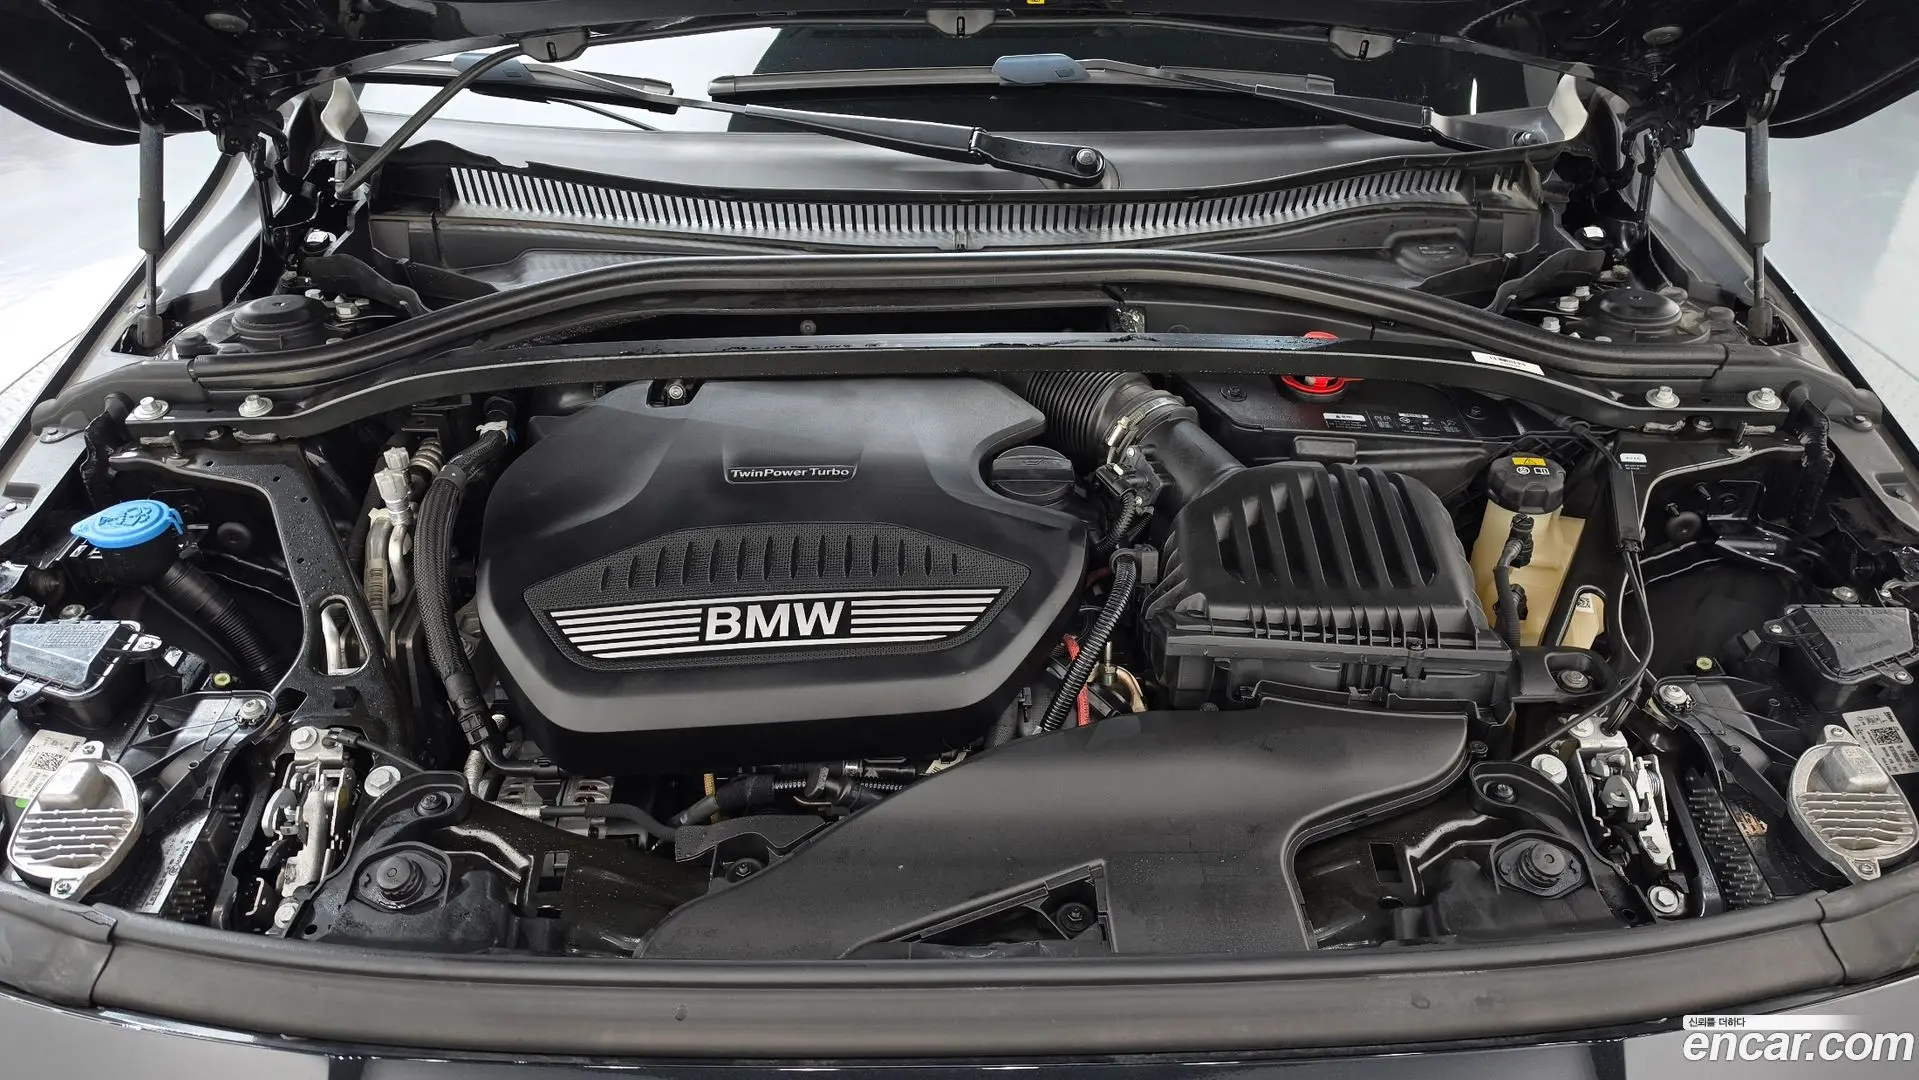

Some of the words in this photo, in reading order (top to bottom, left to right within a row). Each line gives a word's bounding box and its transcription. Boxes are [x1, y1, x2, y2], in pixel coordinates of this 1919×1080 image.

[730, 468, 808, 479] TwinPower
[809, 467, 850, 477] Turbo
[705, 601, 845, 641] BMW
